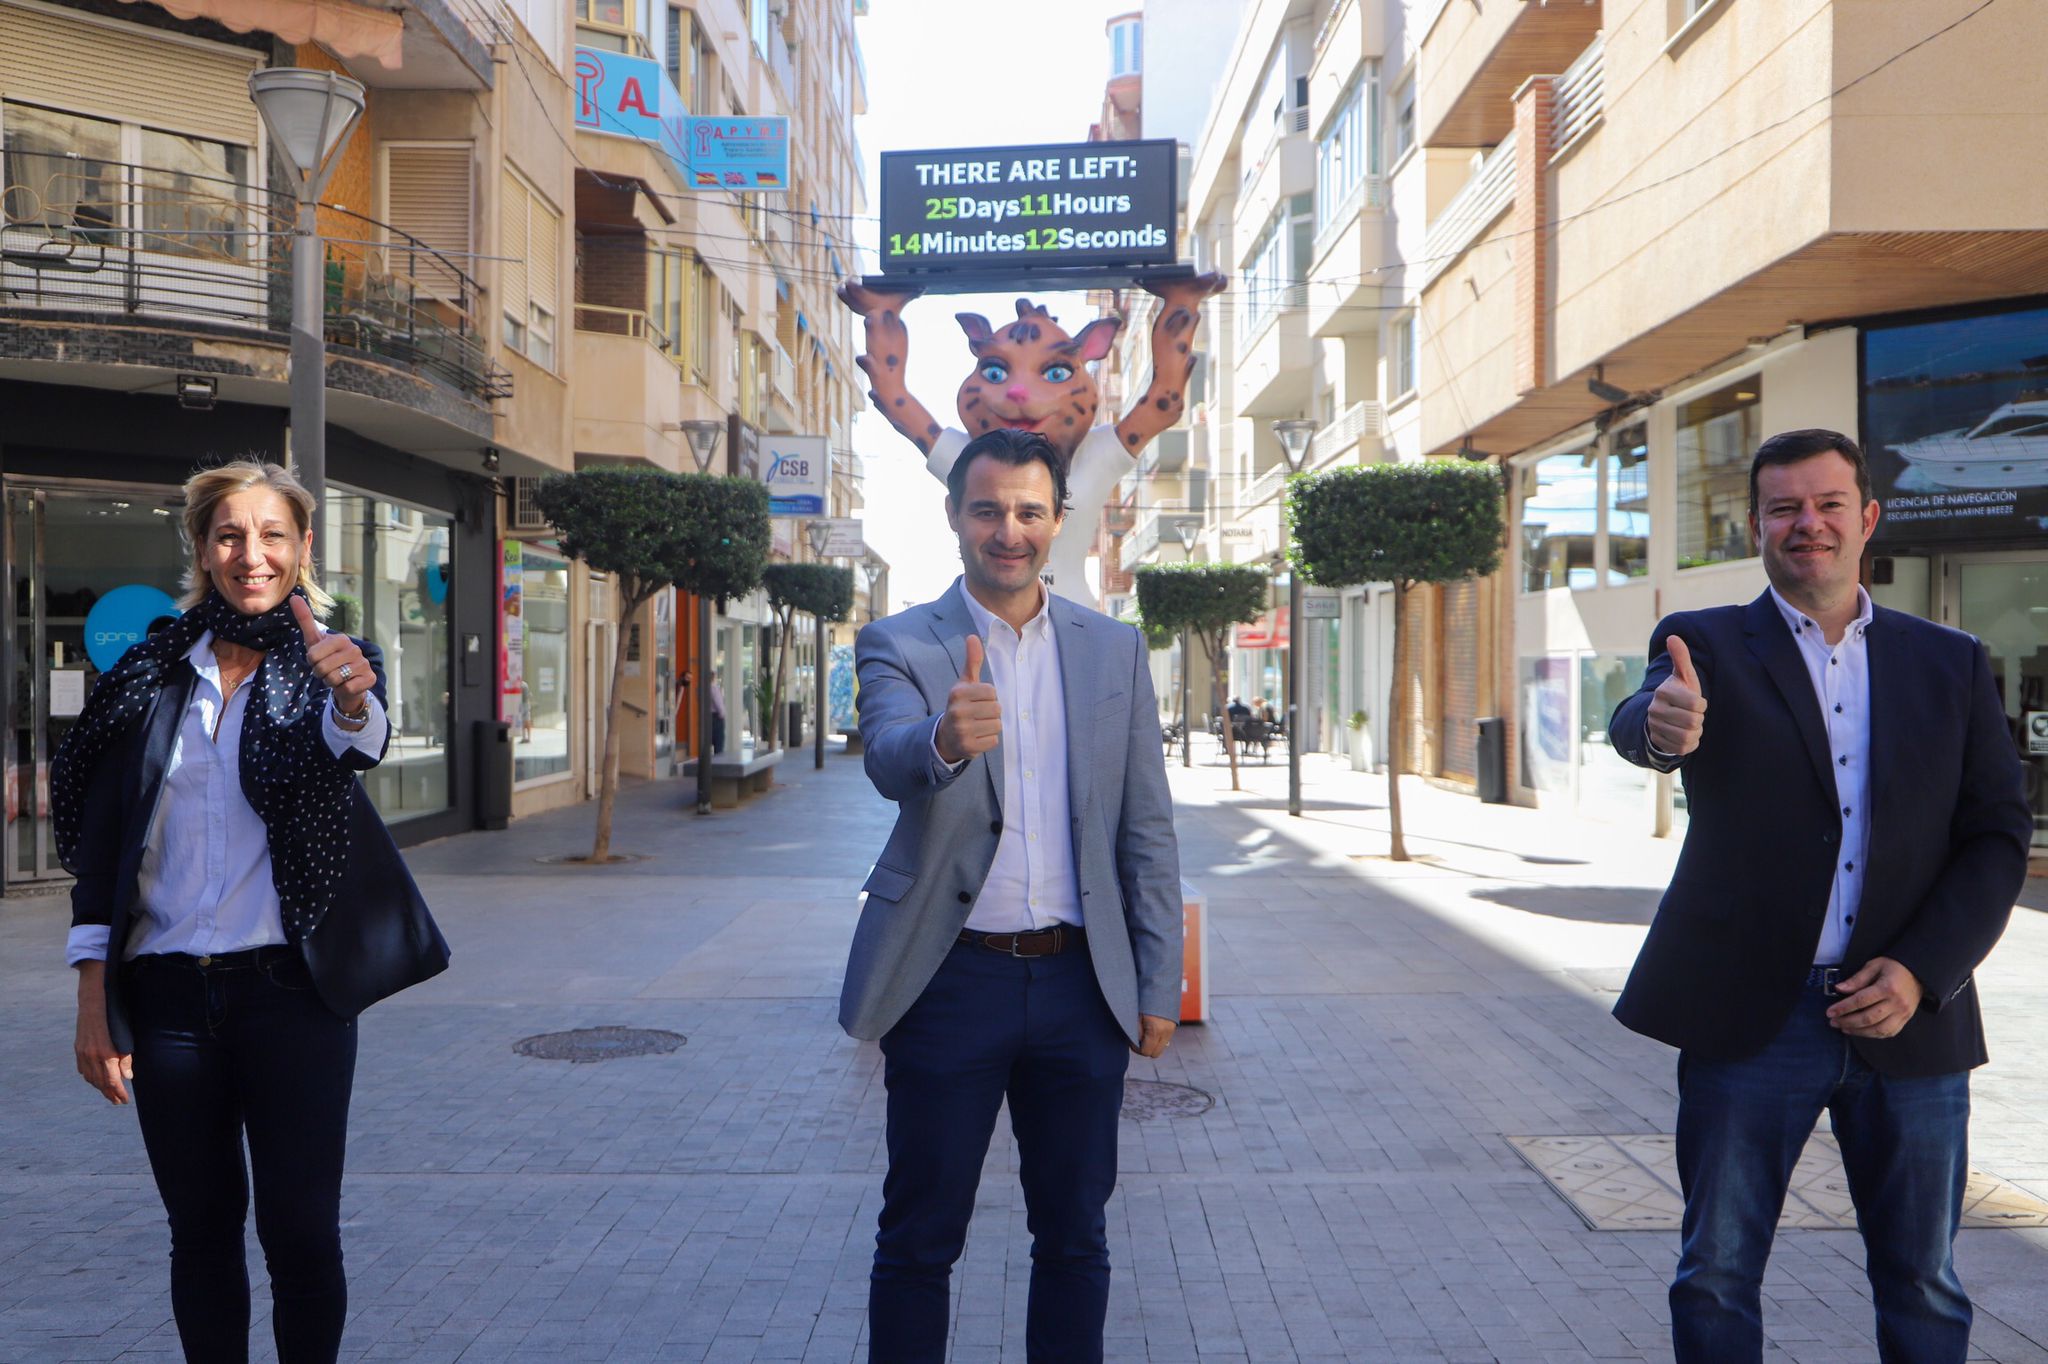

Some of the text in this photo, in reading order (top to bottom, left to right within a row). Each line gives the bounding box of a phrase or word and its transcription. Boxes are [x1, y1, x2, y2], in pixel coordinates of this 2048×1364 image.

[915, 156, 1138, 186] THERE ARE LEFT:
[780, 460, 809, 476] CSB
[1887, 489, 2017, 509] LICENCIA DE NAVEGACIÓN
[1887, 511, 1919, 521] ESCUELA
[1955, 507, 1985, 517] MARINE
[1987, 505, 2014, 515] BREEZE
